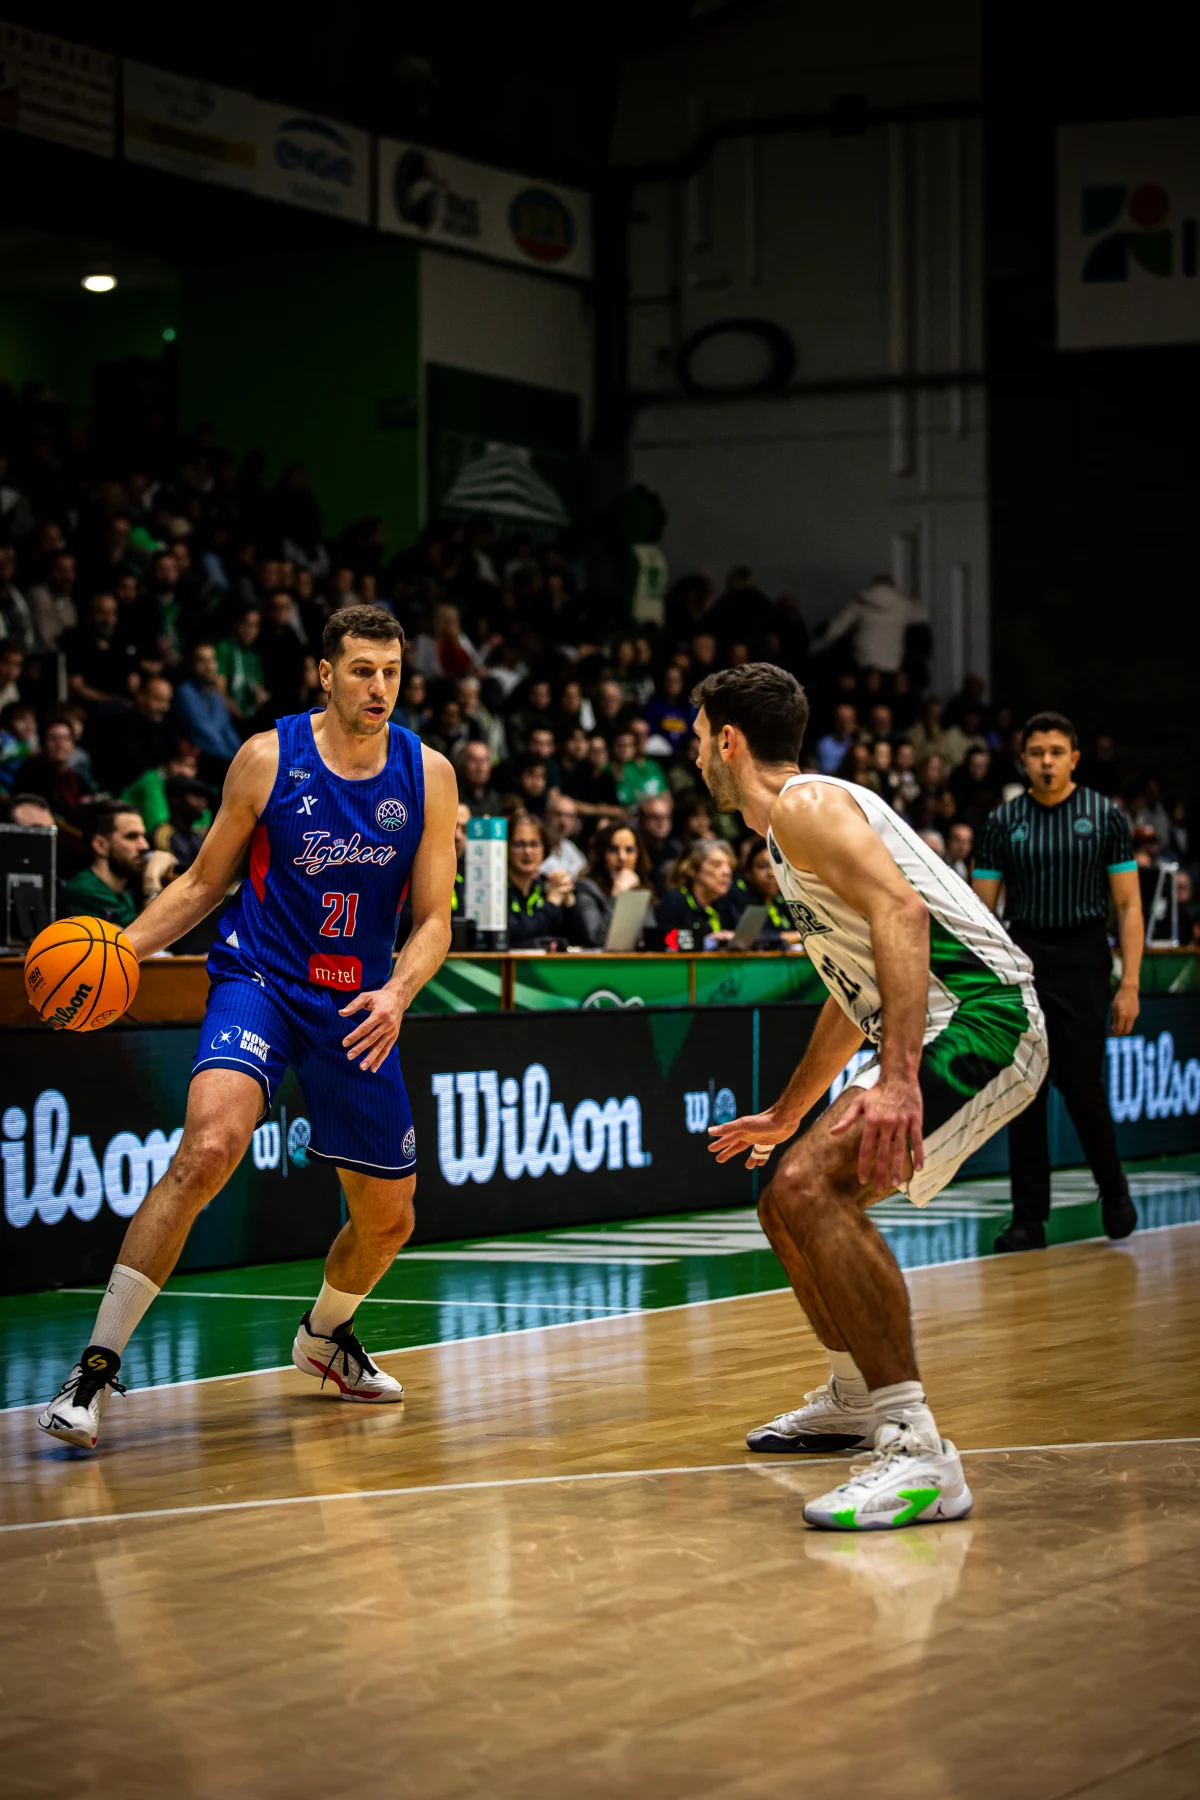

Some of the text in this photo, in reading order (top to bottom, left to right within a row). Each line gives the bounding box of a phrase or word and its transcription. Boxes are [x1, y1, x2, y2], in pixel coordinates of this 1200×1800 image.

[294, 831, 397, 876] Igokea
[320, 892, 359, 937] 21
[315, 966, 355, 984] m:tel
[242, 1030, 271, 1051] NOVA
[432, 1062, 643, 1187] Wilson
